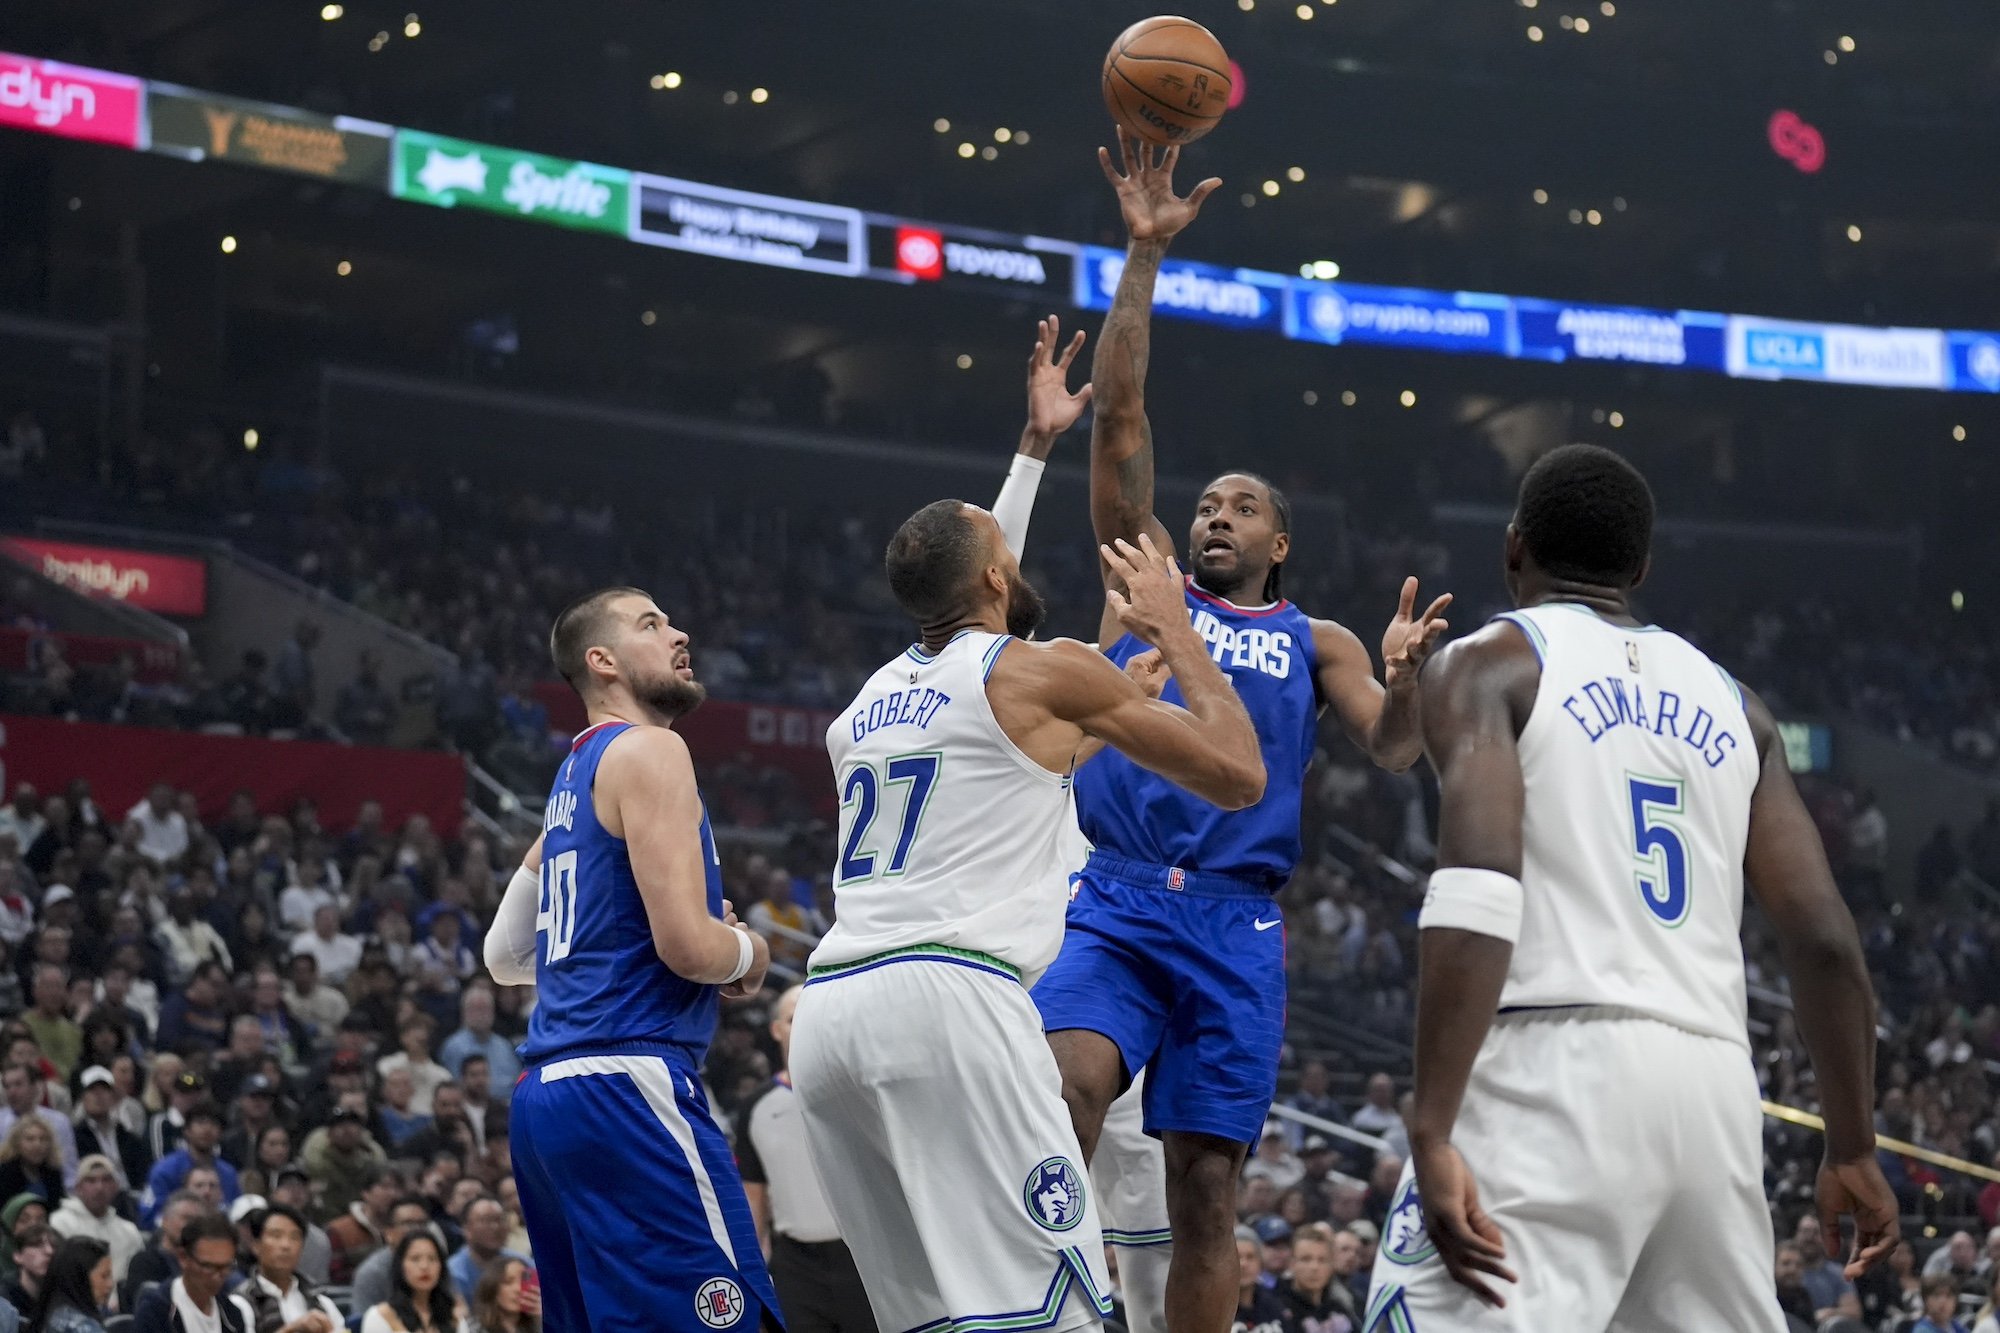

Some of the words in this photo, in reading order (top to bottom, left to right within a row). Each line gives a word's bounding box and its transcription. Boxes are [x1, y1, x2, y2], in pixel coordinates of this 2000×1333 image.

[502, 160, 612, 218] Sprite
[945, 242, 1047, 284] TOYOTA
[1100, 255, 1261, 318] Sectrum
[1347, 302, 1491, 337] crypto.com
[1556, 308, 1684, 340] AMERICAN
[1573, 333, 1687, 365] EXPRESS
[1752, 335, 1818, 365] UCLA
[1188, 607, 1292, 680] IPPERS
[852, 688, 951, 743] GOBERT
[1562, 676, 1736, 768] EDWARDS
[543, 790, 578, 840] UBAC
[837, 751, 943, 888] 27
[1625, 768, 1692, 929] 5
[536, 850, 577, 966] 40
